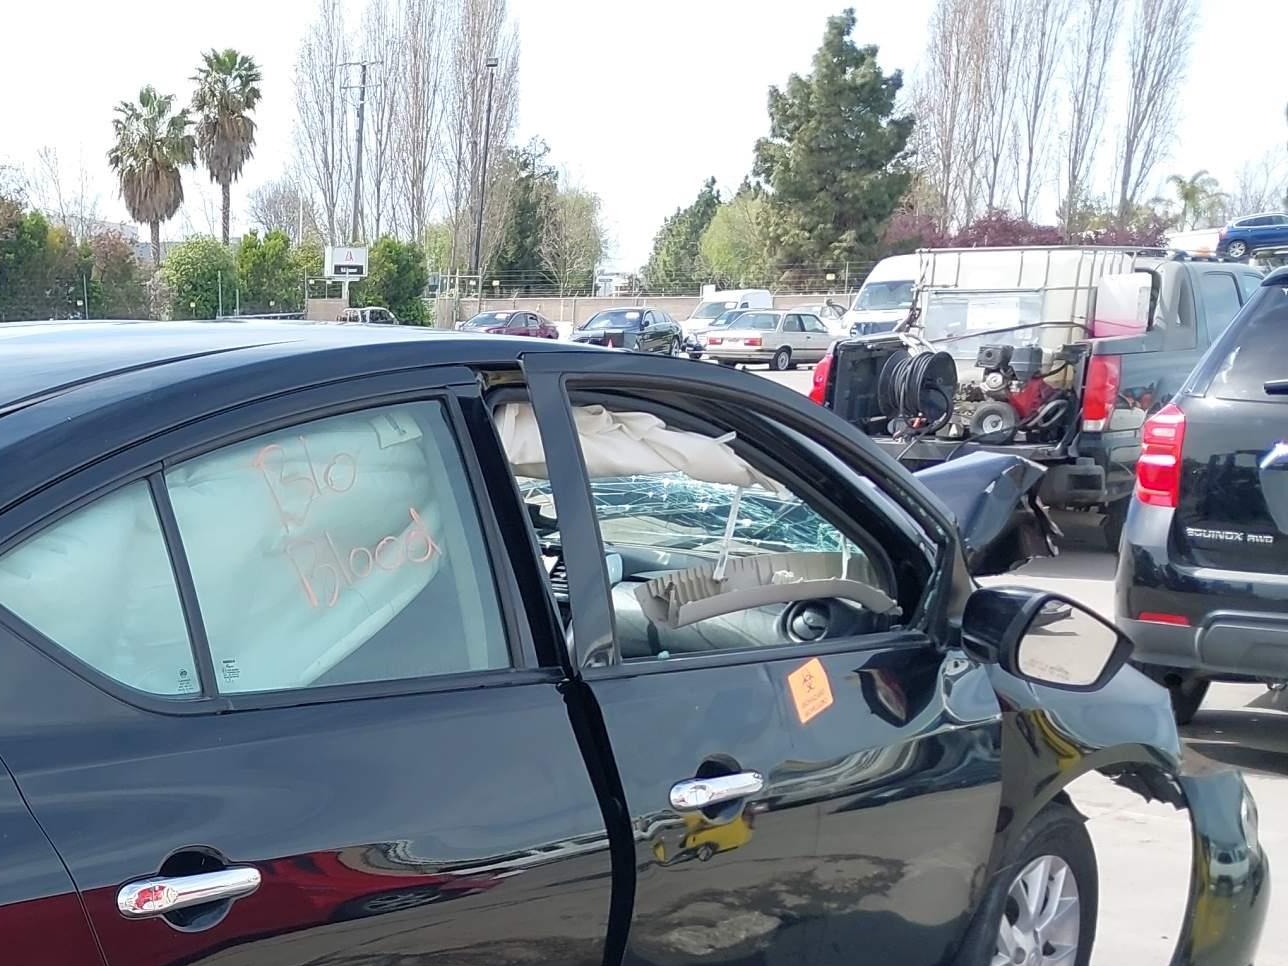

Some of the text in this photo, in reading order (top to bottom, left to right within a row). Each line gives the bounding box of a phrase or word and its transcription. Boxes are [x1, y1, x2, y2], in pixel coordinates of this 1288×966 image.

[283, 506, 444, 608] Blood
[1186, 527, 1274, 544] EQUINOX AWD
